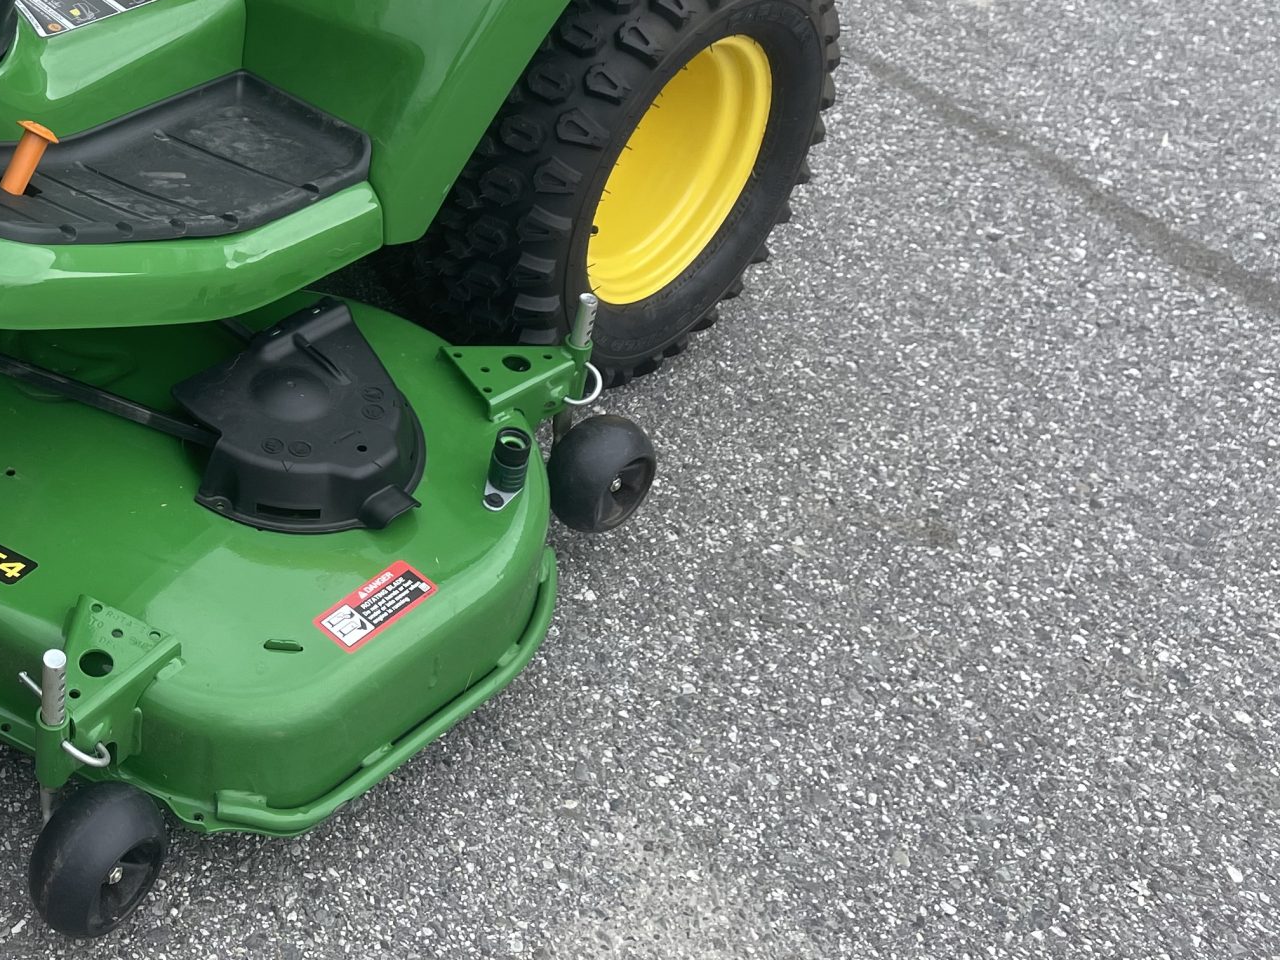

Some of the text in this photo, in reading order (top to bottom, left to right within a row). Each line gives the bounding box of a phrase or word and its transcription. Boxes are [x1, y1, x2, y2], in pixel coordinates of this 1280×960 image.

[360, 576, 406, 610] ROTATING BLADE
[362, 570, 394, 593] DANGER
